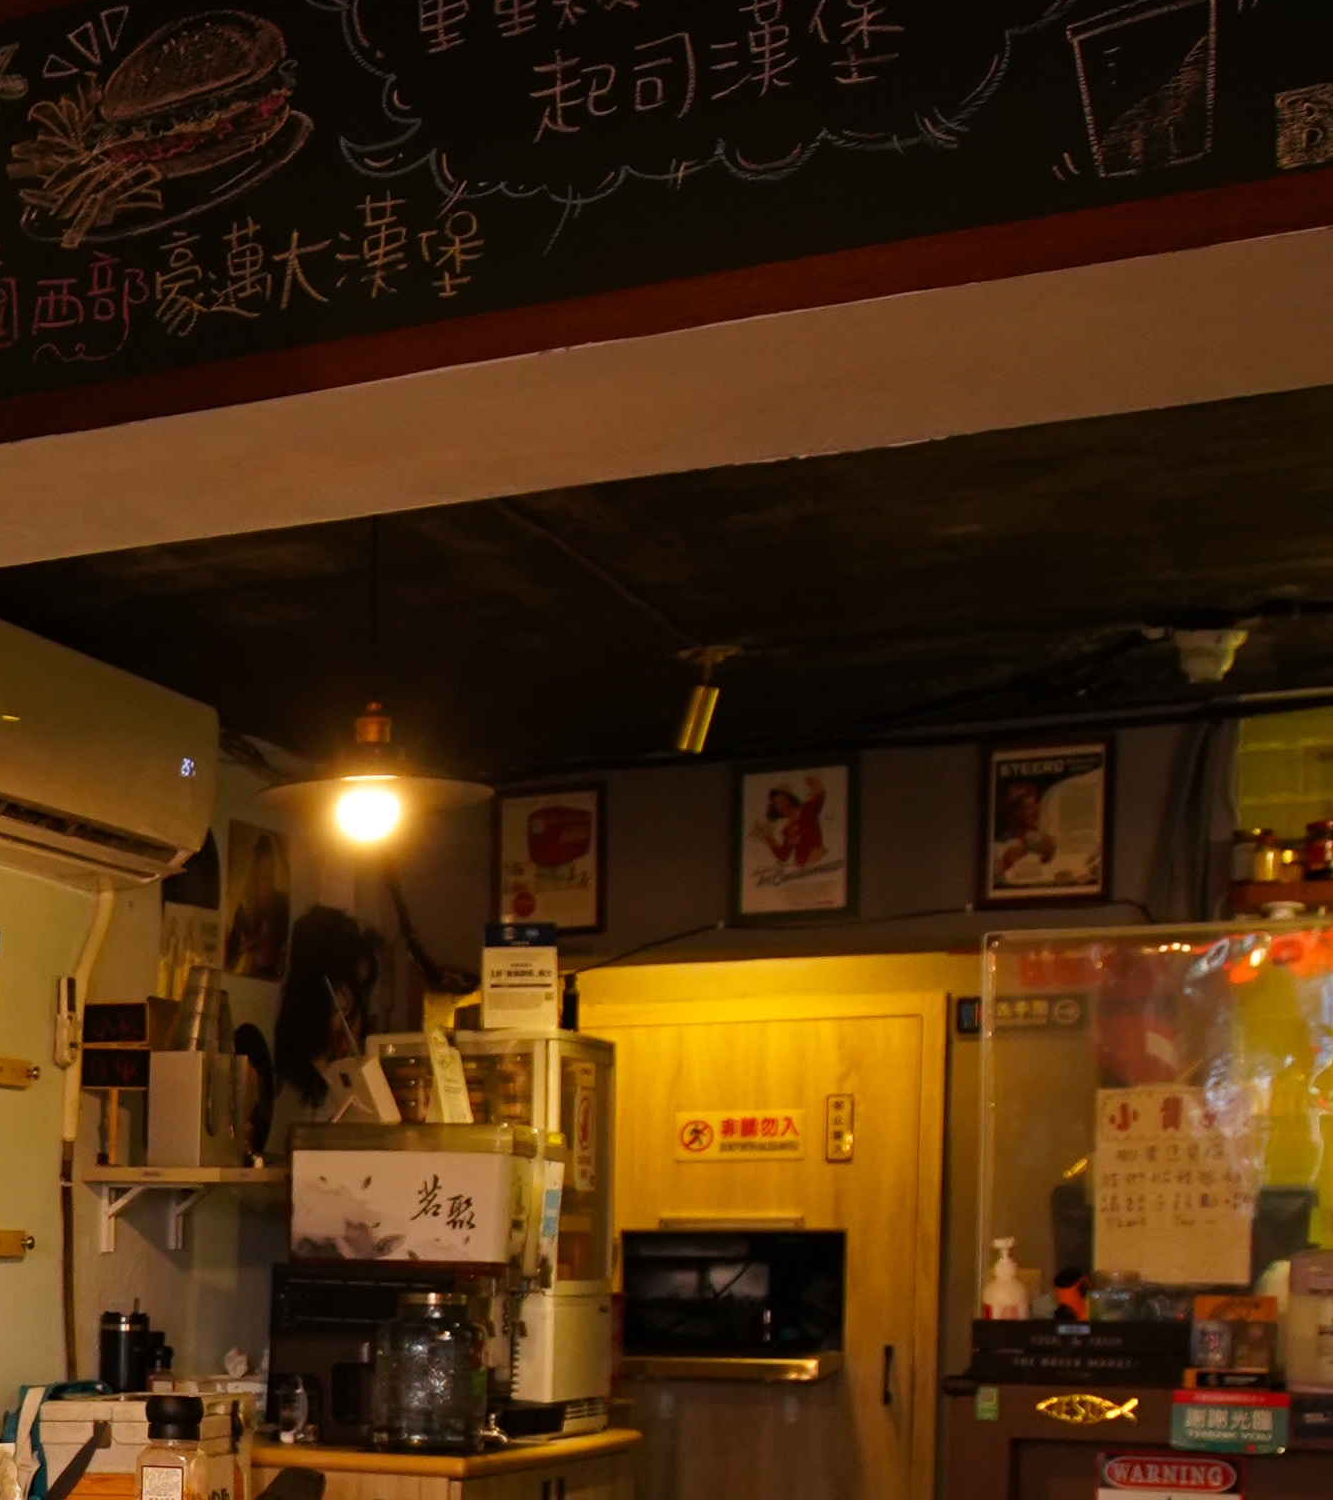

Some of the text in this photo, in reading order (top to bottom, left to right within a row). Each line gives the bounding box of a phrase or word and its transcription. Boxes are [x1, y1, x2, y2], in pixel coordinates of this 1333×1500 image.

[722, 1117, 799, 1137] 非請勿入
[1113, 1464, 1223, 1488] WARNING
